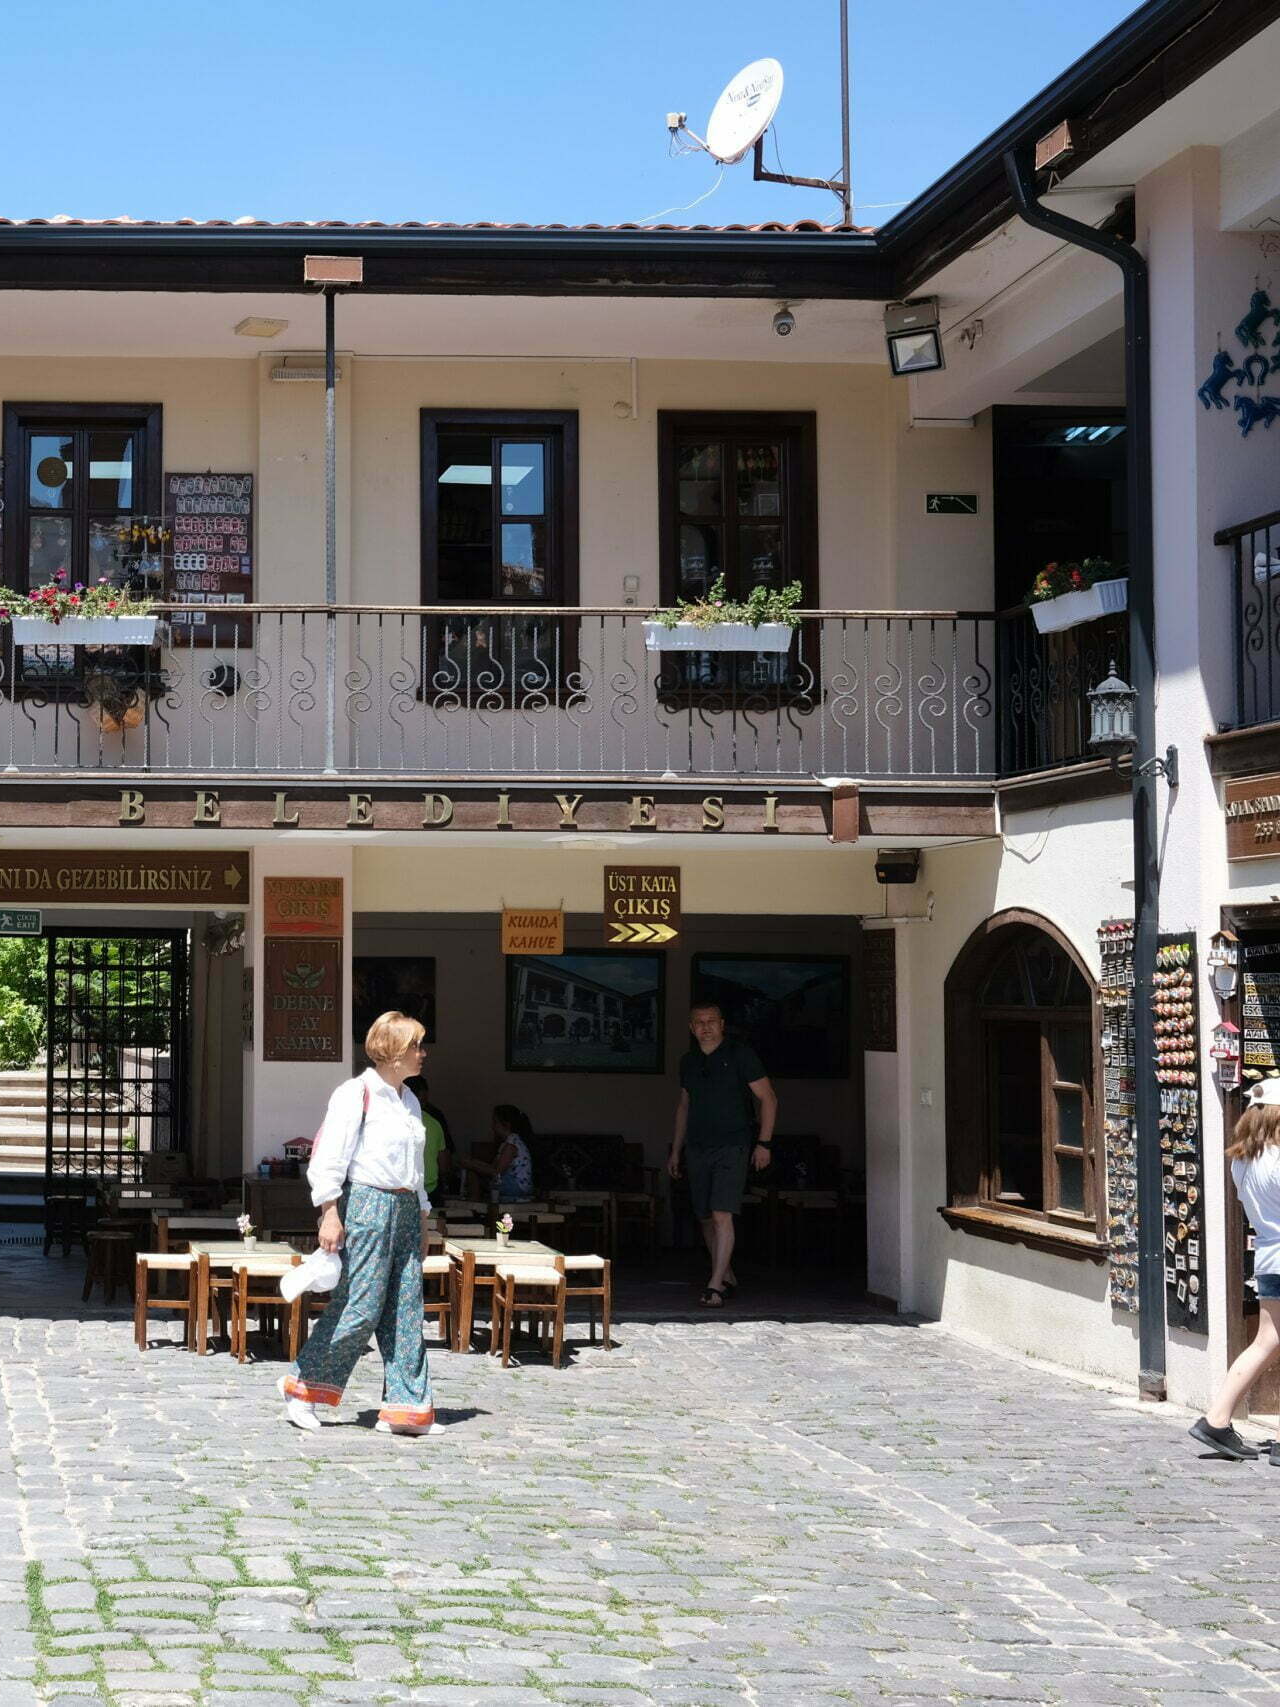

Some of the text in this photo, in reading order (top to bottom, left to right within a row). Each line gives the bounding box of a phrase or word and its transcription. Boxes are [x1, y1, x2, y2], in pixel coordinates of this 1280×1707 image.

[119, 785, 782, 828] BELEDİYESİ
[24, 869, 52, 891] DA
[608, 872, 677, 892] ÜST KATA
[614, 898, 671, 919] ÇIKIŞ
[17, 921, 36, 929] EXIT
[507, 915, 558, 929] KUMDA
[275, 1036, 332, 1051] KAHVE
